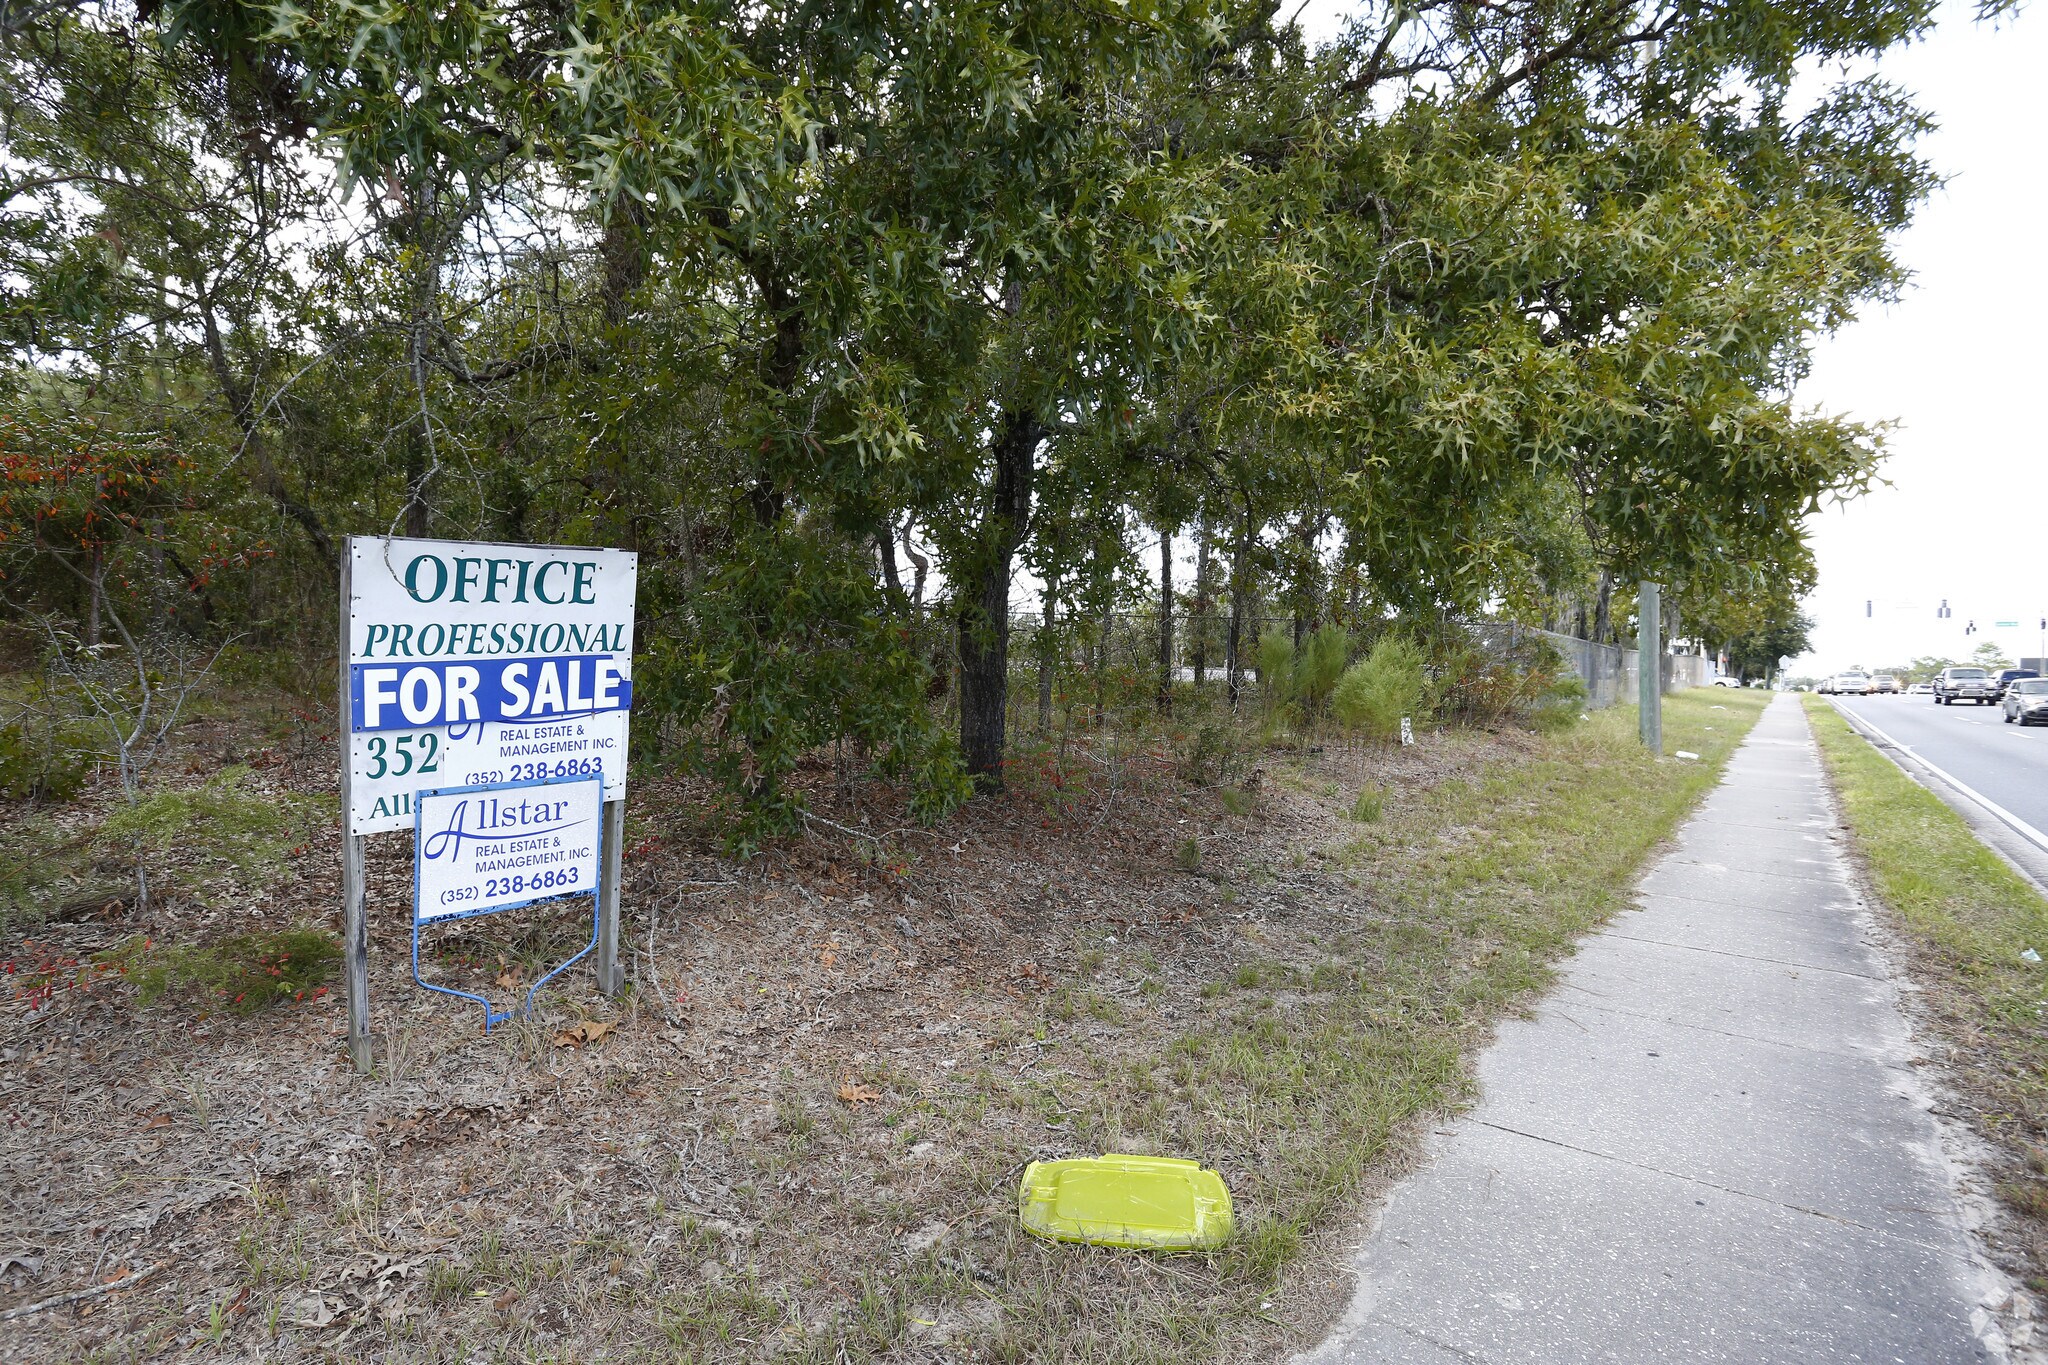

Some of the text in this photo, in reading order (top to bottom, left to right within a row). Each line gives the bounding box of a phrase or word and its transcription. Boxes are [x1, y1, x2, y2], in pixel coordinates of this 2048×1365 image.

[404, 554, 597, 605] OFFICE
[361, 622, 628, 658] PROFESSIONAL
[363, 658, 621, 728] FOR SALE
[500, 728, 530, 742] REAL
[534, 725, 573, 739] ESTATE
[576, 724, 585, 736] &
[500, 737, 617, 758] MANAGEMENT INC.
[366, 733, 439, 780] 352
[465, 756, 603, 786] (352) 238-6863
[368, 792, 416, 820] All
[424, 798, 569, 863] Allstar
[475, 836, 561, 858] REAL ESTATE &
[475, 847, 593, 874] MANAGEMENT, INC.
[440, 866, 579, 906] (352) 238-6863
